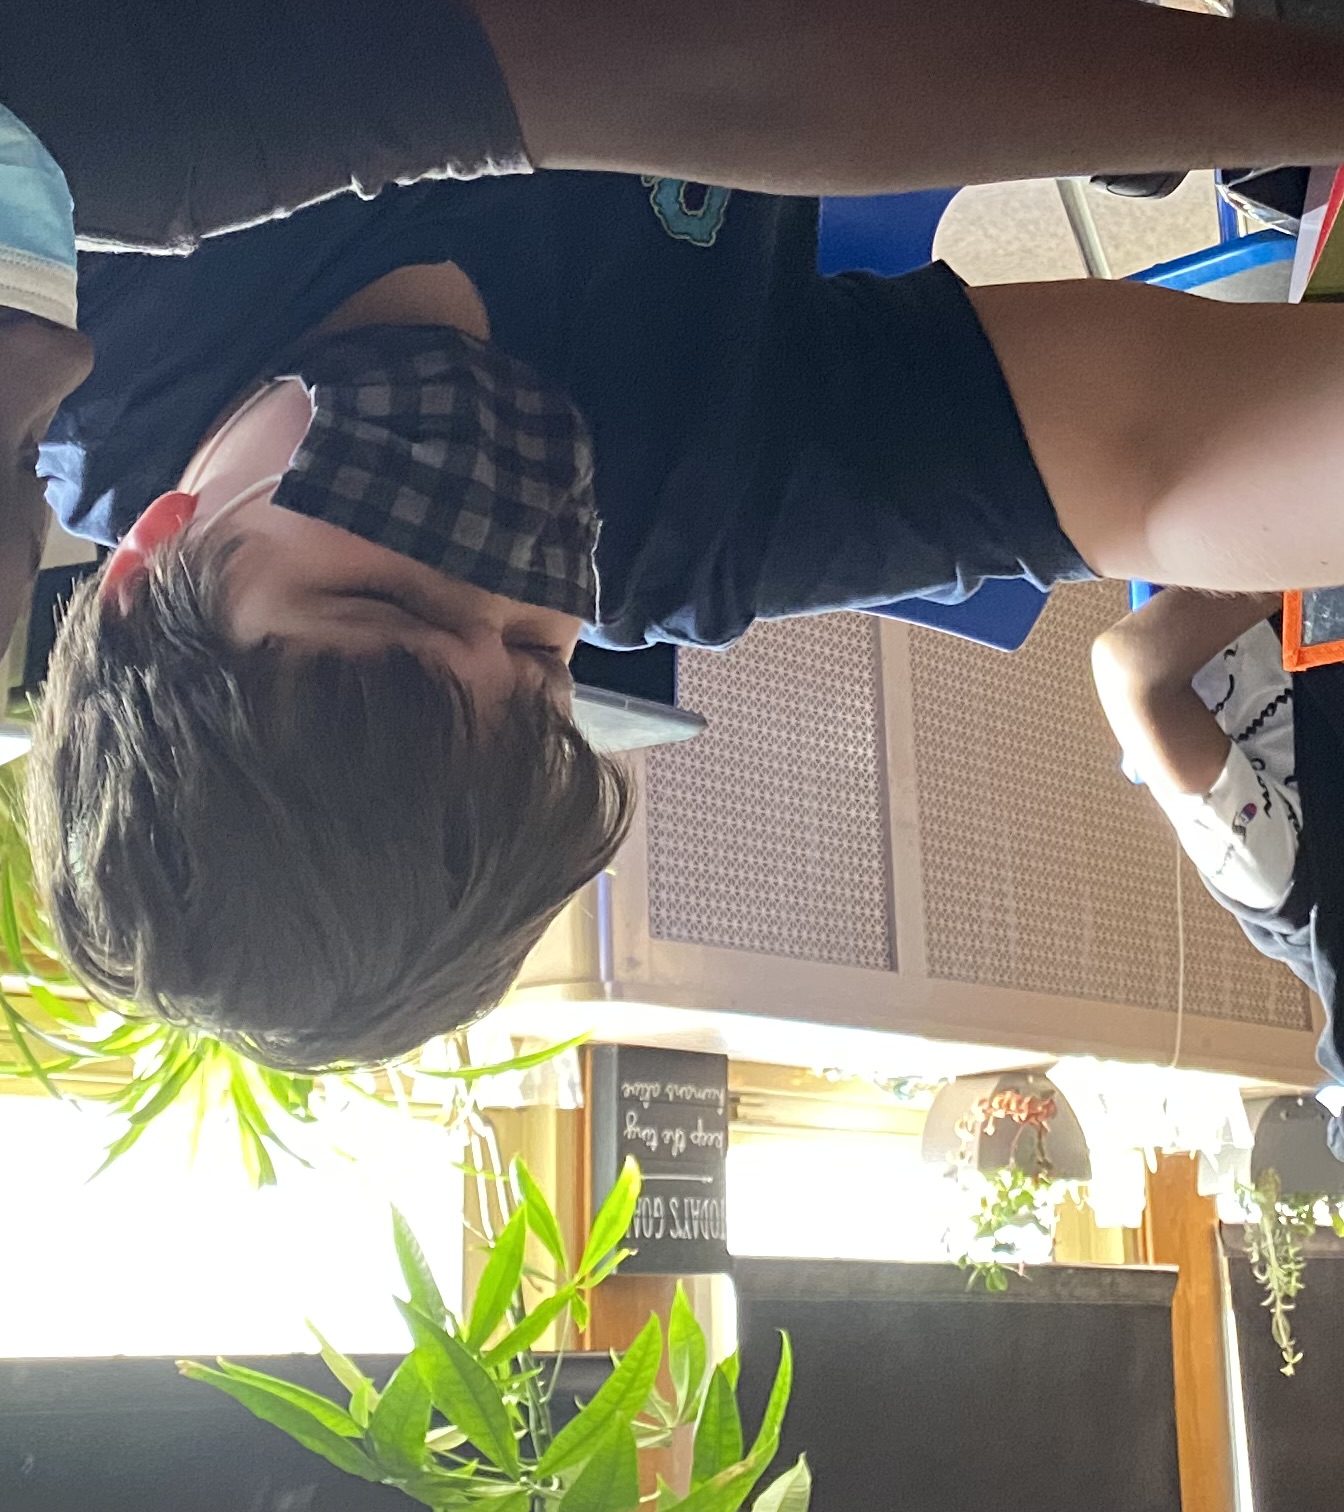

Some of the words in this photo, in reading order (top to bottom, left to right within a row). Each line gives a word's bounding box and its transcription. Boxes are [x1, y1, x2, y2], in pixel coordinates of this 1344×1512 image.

[621, 1081, 661, 1110] alive
[665, 1082, 726, 1116] humans
[623, 1110, 658, 1152] tiny
[662, 1126, 686, 1158] the
[689, 1117, 725, 1156] keep
[625, 1196, 665, 1241] GOA
[668, 1196, 726, 1241] TODAY'S
